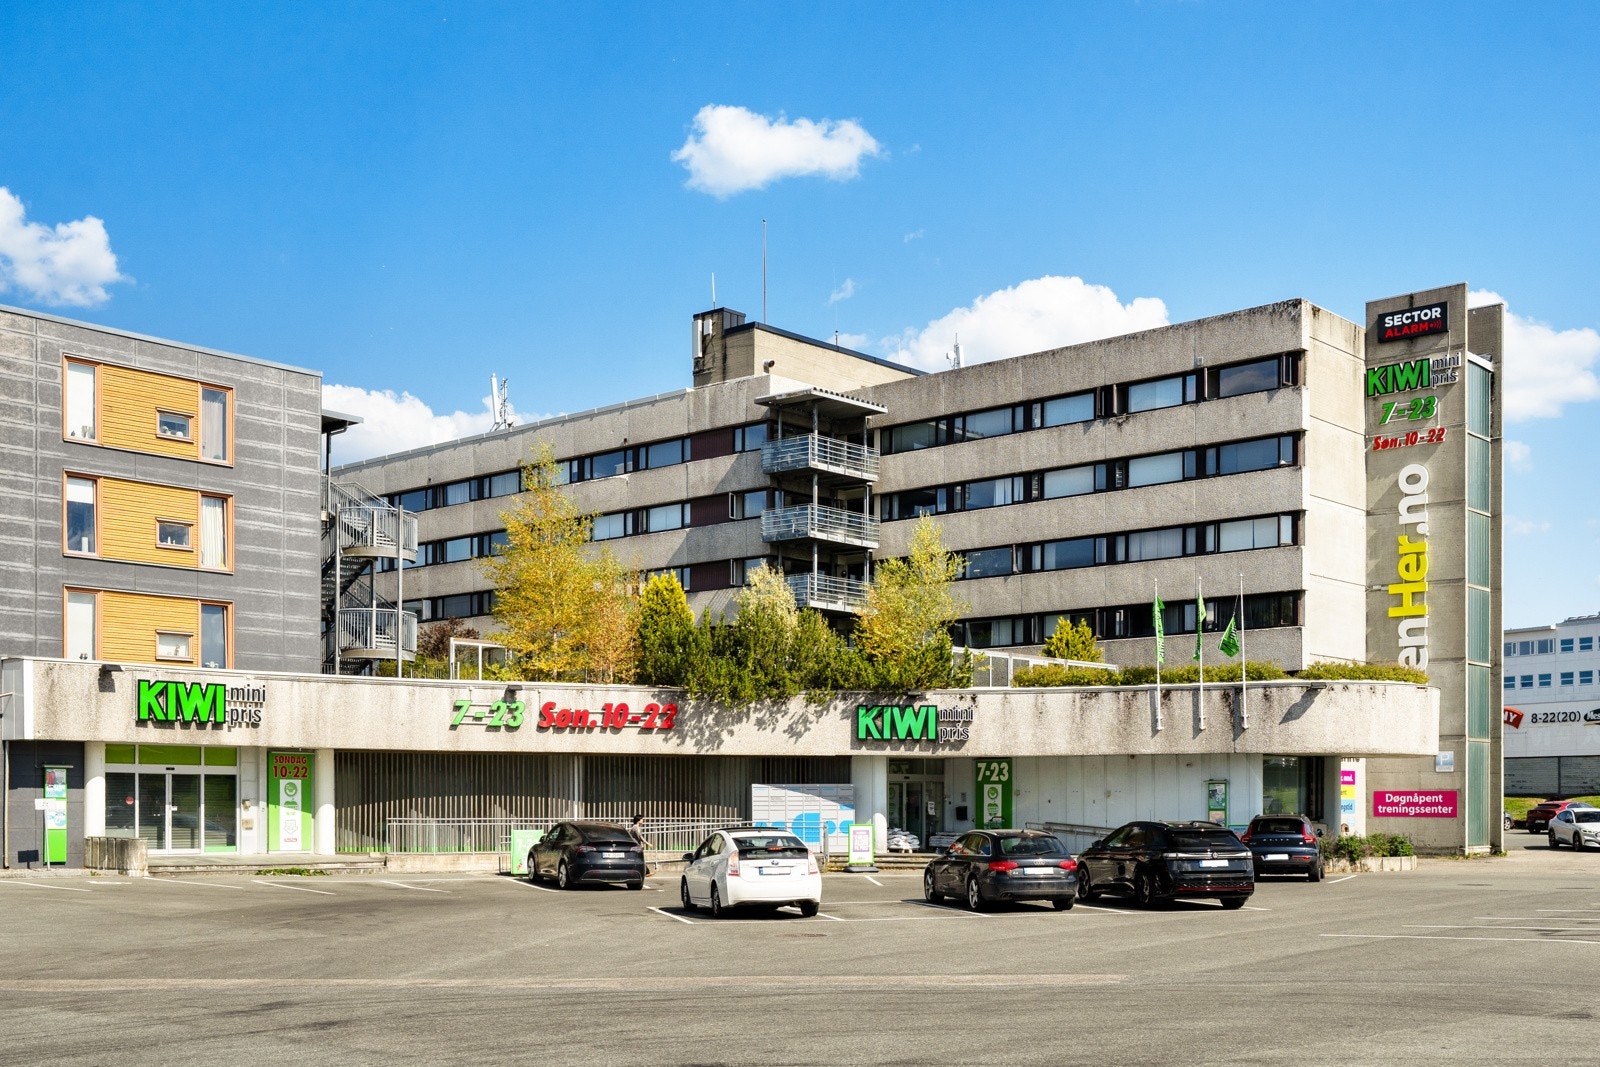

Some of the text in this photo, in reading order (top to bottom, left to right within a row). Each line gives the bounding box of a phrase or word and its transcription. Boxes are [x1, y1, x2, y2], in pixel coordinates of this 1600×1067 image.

[1384, 307, 1442, 328] SECTOR
[1385, 323, 1430, 338] ALARM
[1432, 352, 1461, 371] mini
[1366, 358, 1431, 398] KIWI
[1431, 370, 1459, 389] pris
[138, 679, 266, 723] KIWI mini
[229, 705, 262, 726] pris
[538, 701, 597, 729] Søn.
[857, 704, 974, 742] KIWI mini
[1531, 711, 1581, 724] 8-22(20)
[939, 725, 970, 743] pris
[274, 755, 307, 765] SØNDAG
[1440, 753, 1450, 766] P
[977, 762, 1010, 782] 7-23
[1385, 793, 1443, 805] Døgnåpent
[1378, 804, 1453, 816] treningssenter
